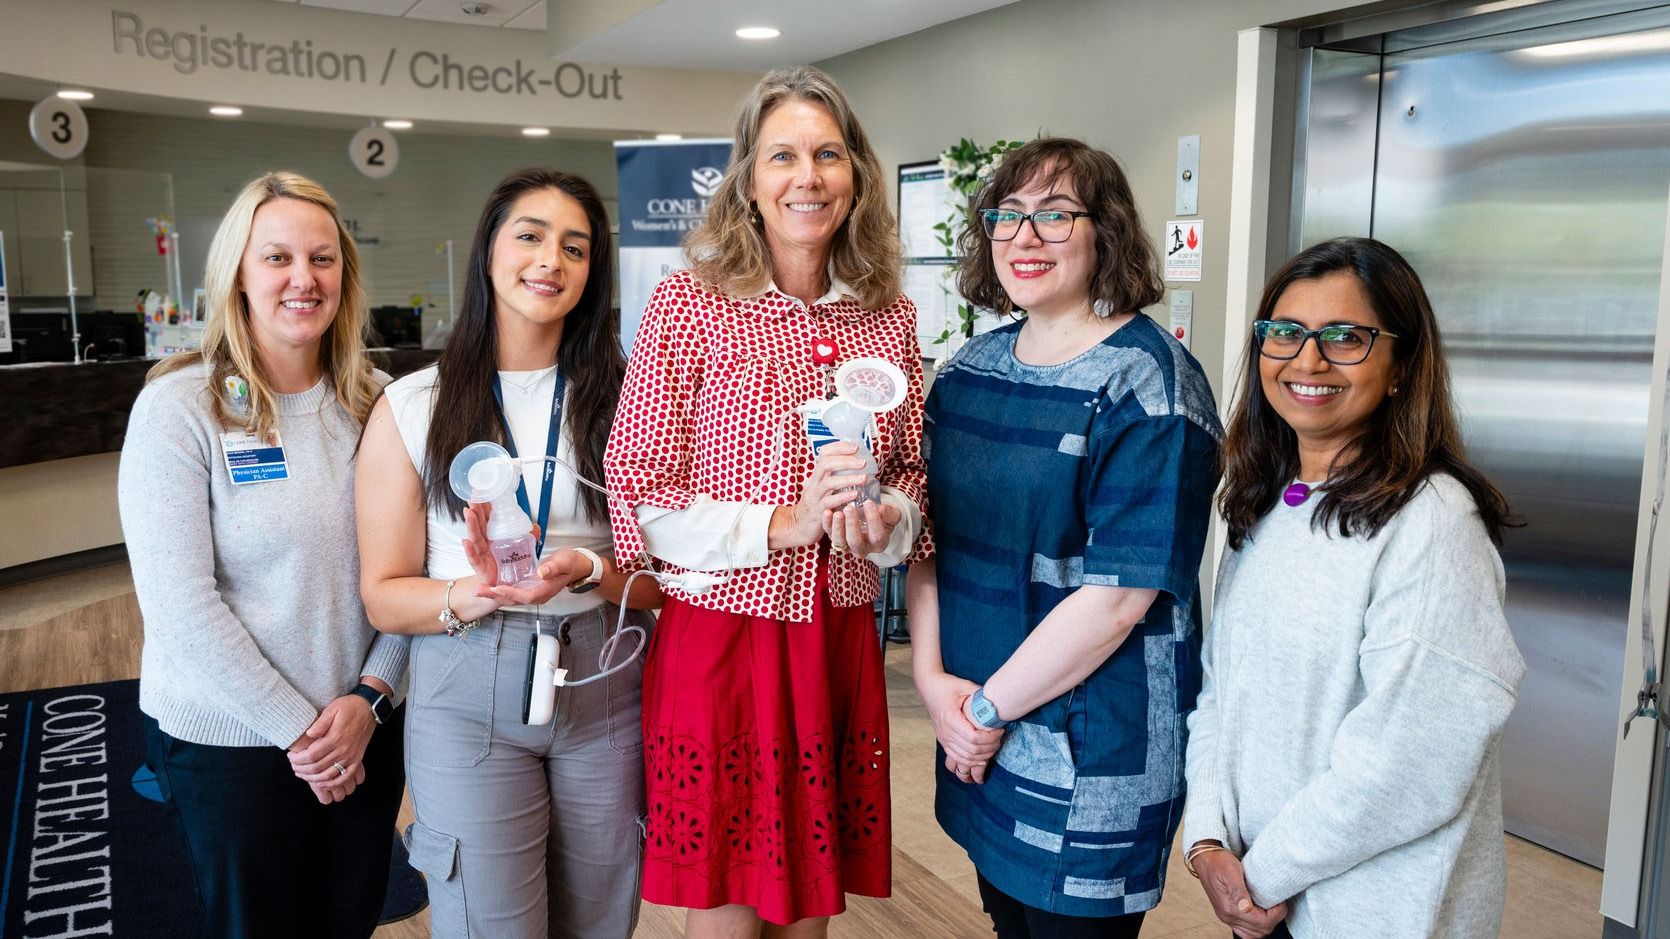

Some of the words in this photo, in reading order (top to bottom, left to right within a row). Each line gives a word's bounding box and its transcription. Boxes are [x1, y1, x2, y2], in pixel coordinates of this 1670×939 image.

[111, 9, 367, 83] Registration
[380, 48, 397, 86] /
[409, 51, 623, 100] Check-Out
[51, 111, 72, 144] 3
[366, 138, 385, 166] 2
[647, 199, 696, 214] CONE
[631, 219, 677, 232] Women's
[233, 468, 260, 477] Physician
[261, 466, 286, 474] Assistant
[39, 694, 107, 773] CONE
[23, 773, 113, 939] HEALTH
